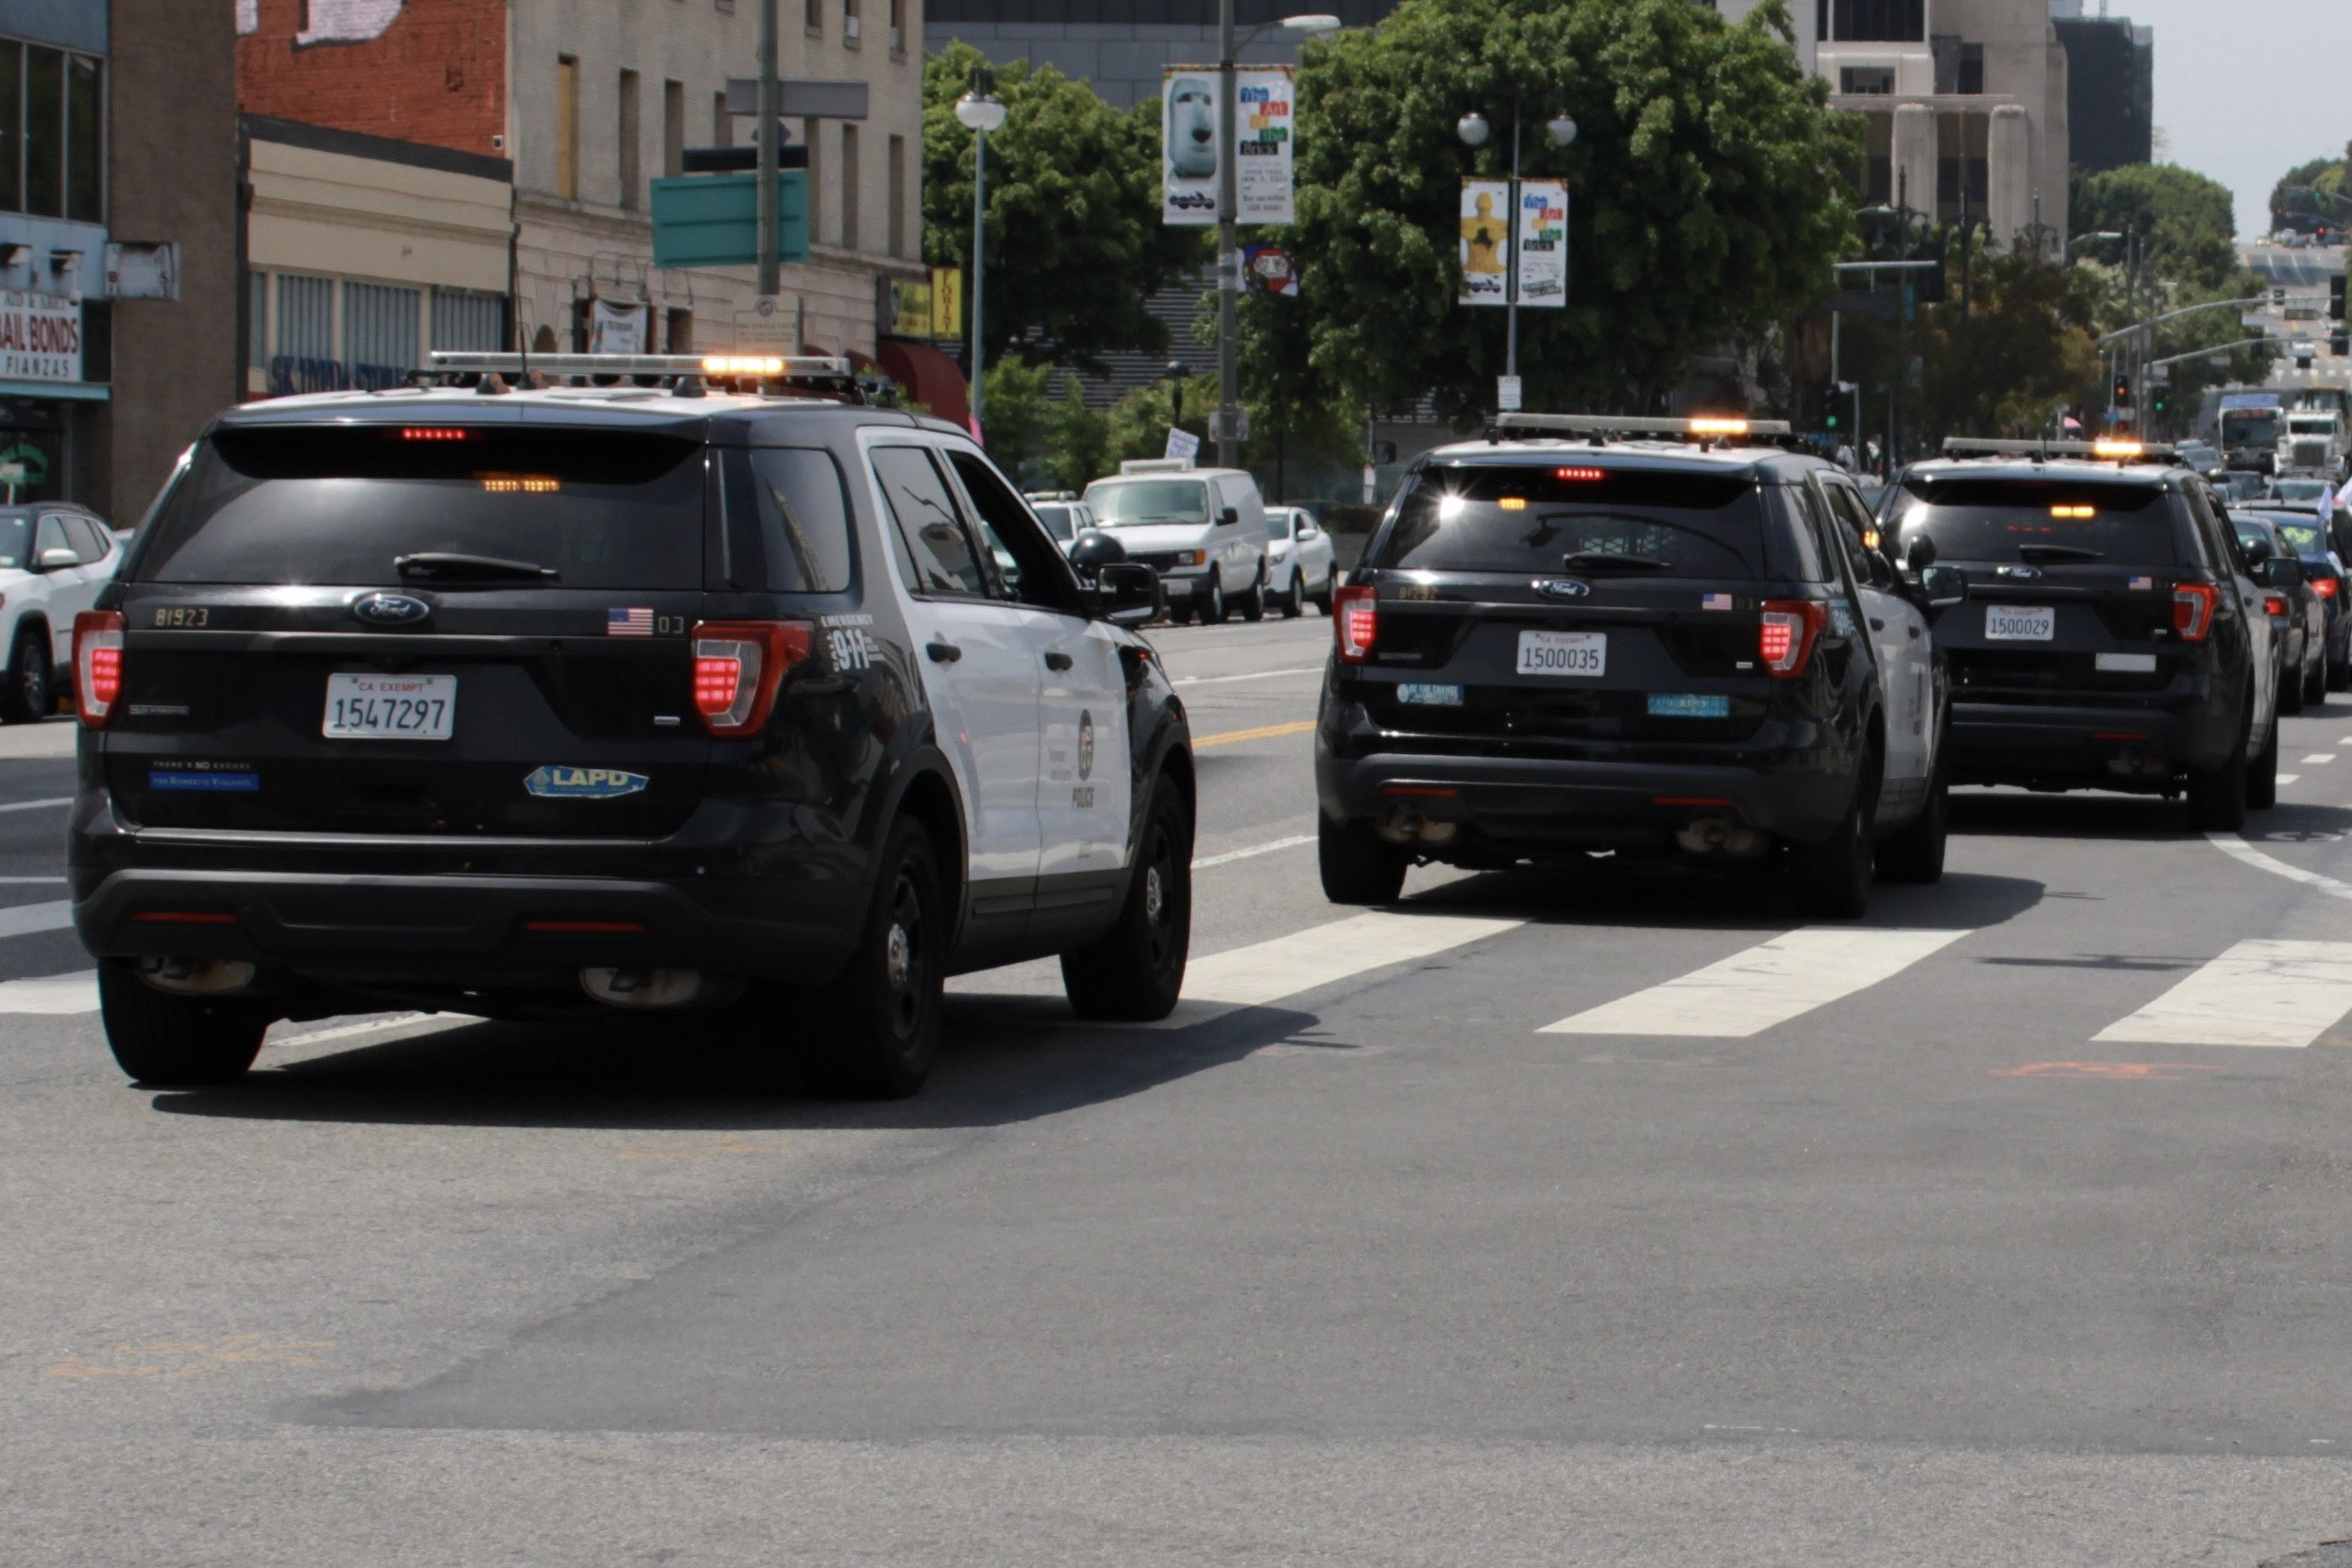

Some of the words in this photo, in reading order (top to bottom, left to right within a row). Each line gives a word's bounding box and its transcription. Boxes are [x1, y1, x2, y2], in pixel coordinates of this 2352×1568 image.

[1243, 143, 1275, 155] Brick
[29, 314, 78, 353] BONDS
[6, 356, 69, 377] FIANZAS
[155, 608, 209, 627] 81923
[658, 615, 684, 633] 03
[821, 614, 873, 628] EMERGENCY
[1990, 617, 2050, 635] 1500029
[832, 628, 871, 670] 911
[1524, 647, 1599, 669] 1500035
[358, 682, 374, 692] CA
[380, 683, 424, 692] EXEMPT
[332, 698, 446, 729] 1547297
[195, 761, 211, 769] NO
[551, 768, 630, 786] LAPD
[1072, 785, 1095, 808] POLICE
